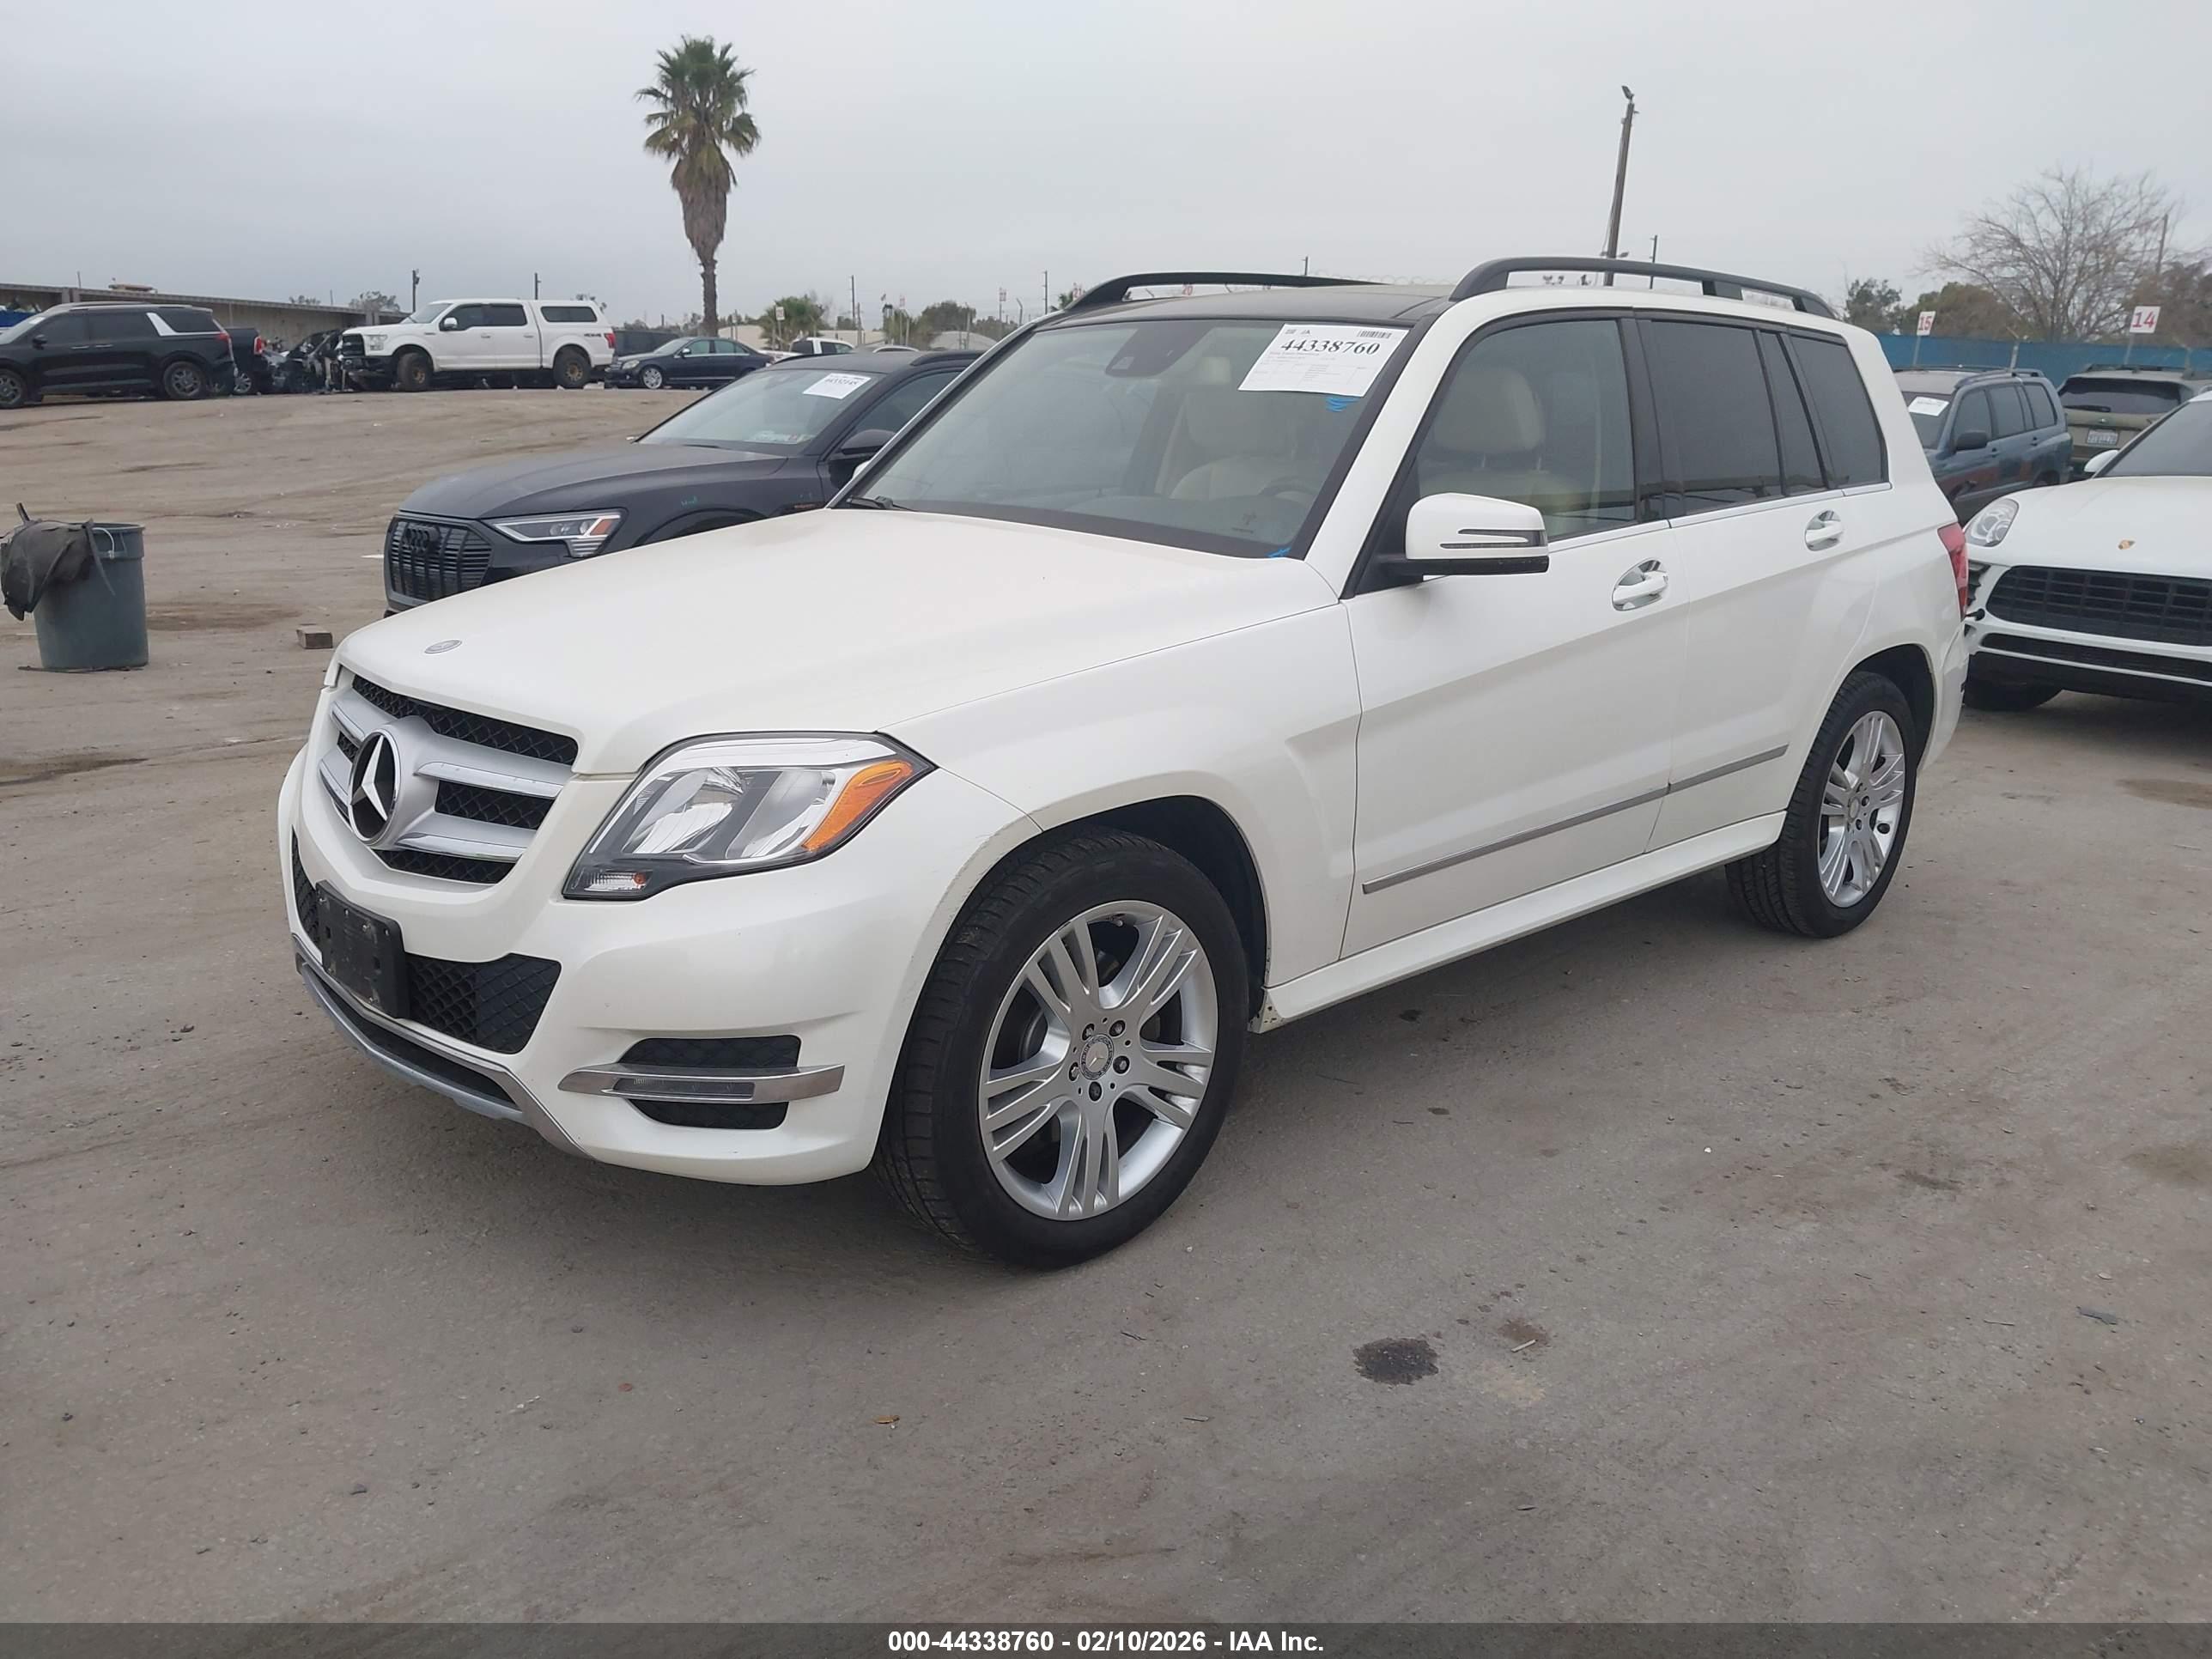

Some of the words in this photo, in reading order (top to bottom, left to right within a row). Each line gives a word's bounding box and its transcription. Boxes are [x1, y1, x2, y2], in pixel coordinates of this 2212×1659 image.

[1917, 315, 1932, 331] 15
[2132, 311, 2155, 328] 14
[1280, 339, 1381, 356] 44338760
